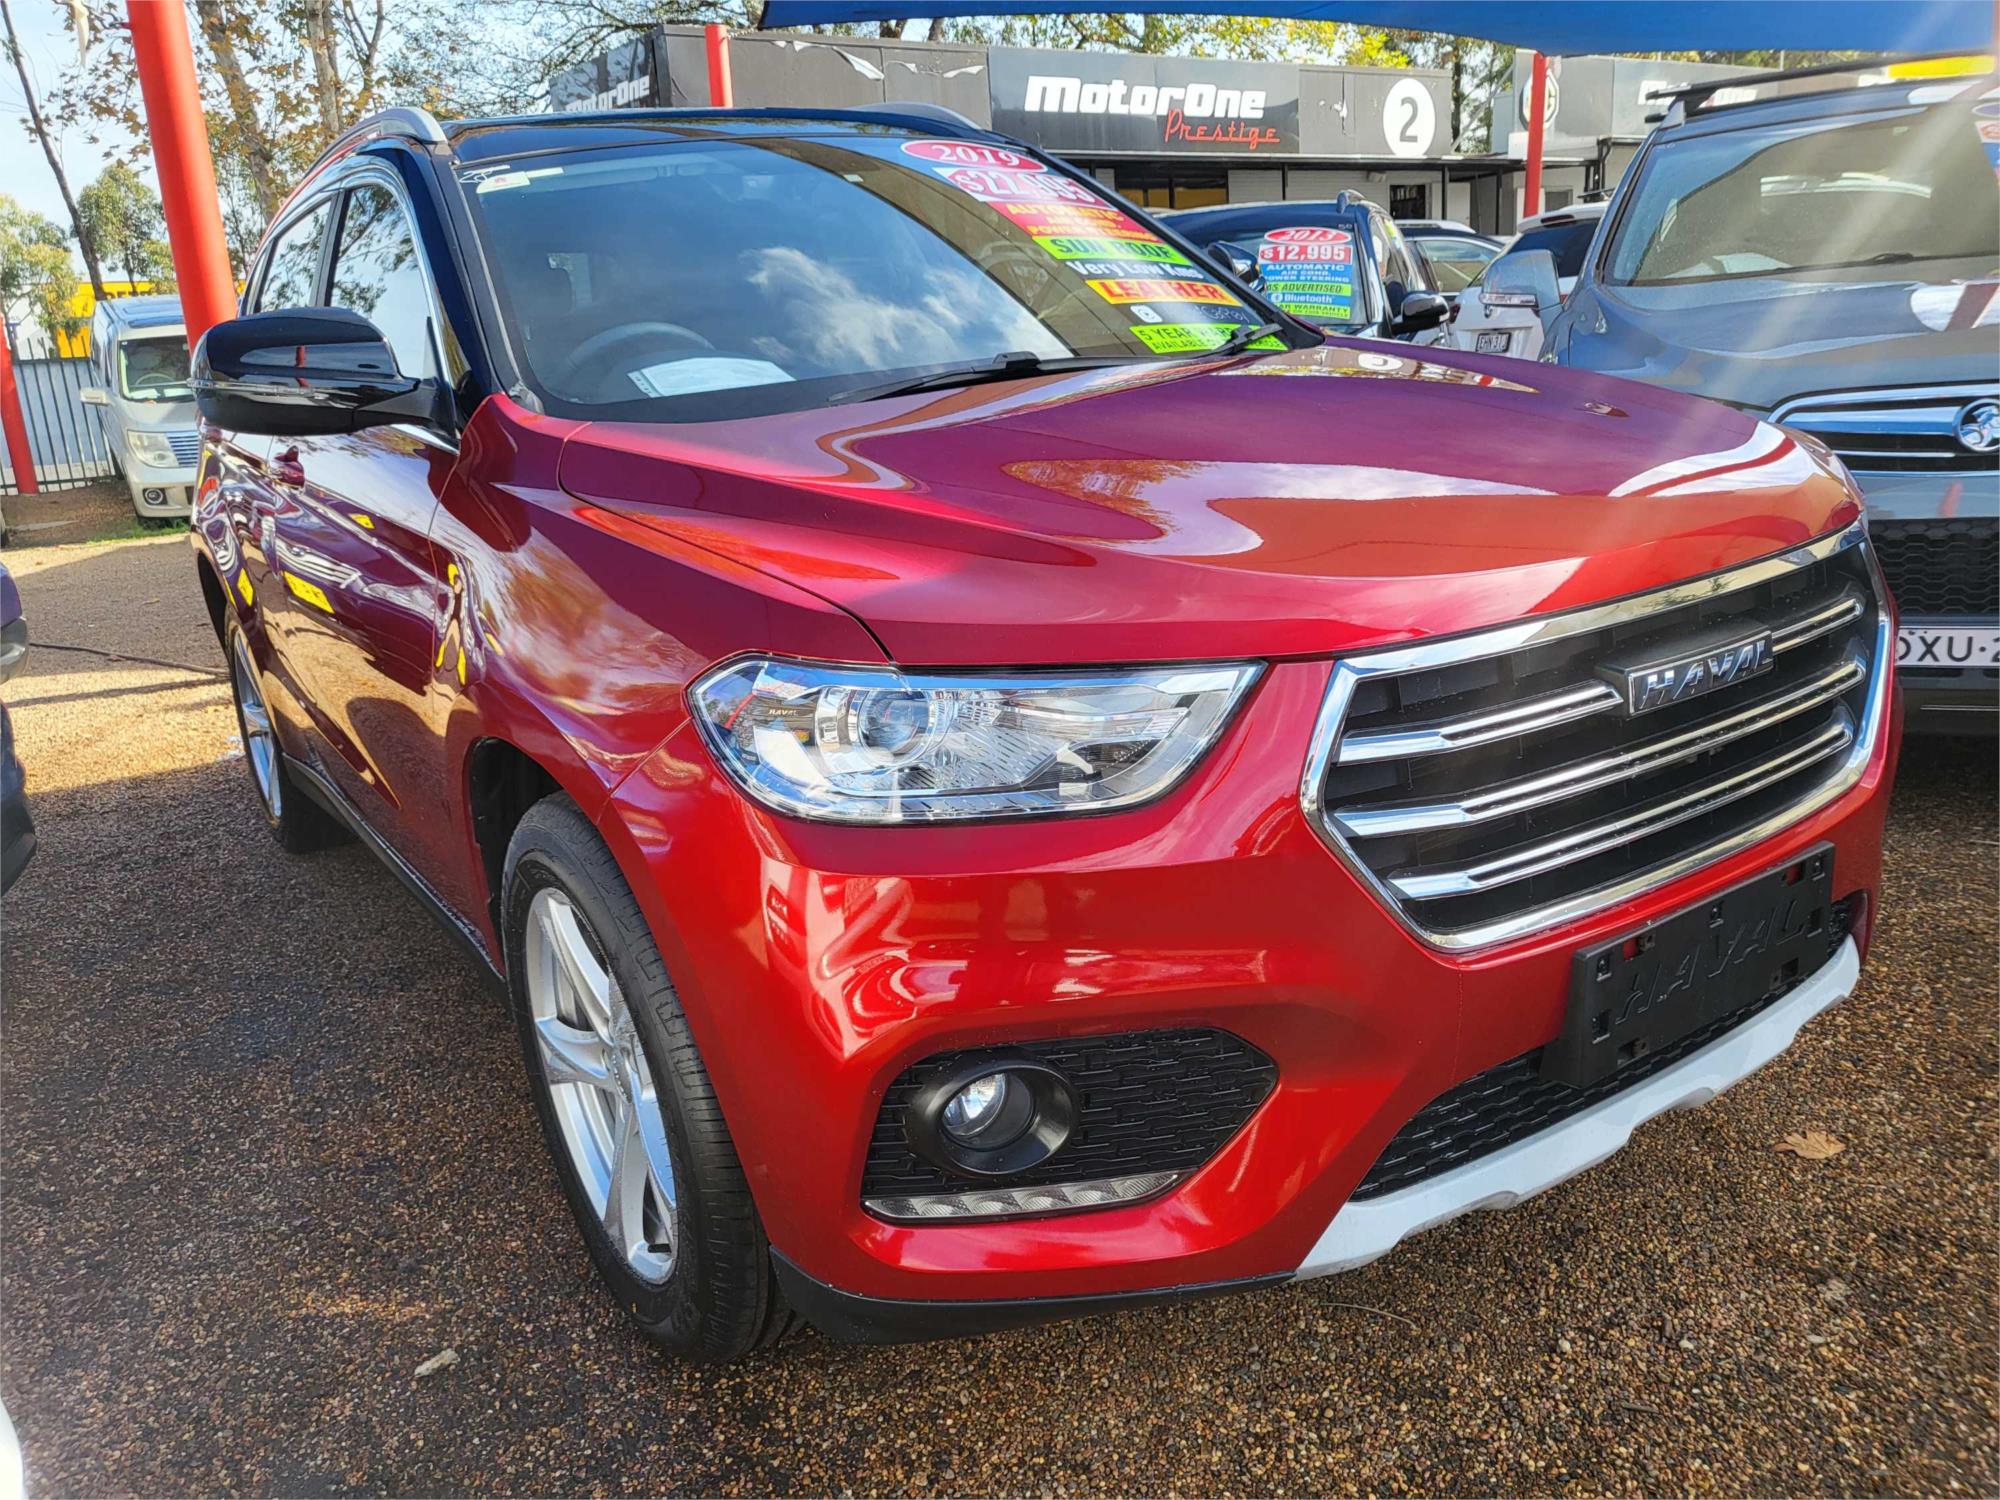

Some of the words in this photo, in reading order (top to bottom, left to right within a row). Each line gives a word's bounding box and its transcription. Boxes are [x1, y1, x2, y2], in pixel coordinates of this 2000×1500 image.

[1024, 75, 1267, 119] MotorOne
[1164, 108, 1280, 150] Prestige
[1399, 97, 1419, 142] 2
[931, 144, 1020, 166] 2019
[1051, 238, 1107, 254] SUN
[1110, 240, 1171, 258] ROOF
[1263, 245, 1345, 261] $12,995
[1065, 261, 1125, 277] Very
[1119, 261, 1165, 275] Low
[1100, 280, 1226, 300] LEATHER
[1282, 284, 1342, 293] ADVERTISED
[1284, 293, 1333, 304] Bluetooth
[1139, 329, 1153, 341] 5
[1151, 328, 1193, 340] YEAR
[1638, 638, 1773, 711] HAVAL
[1614, 897, 1808, 1026] HAVAL
